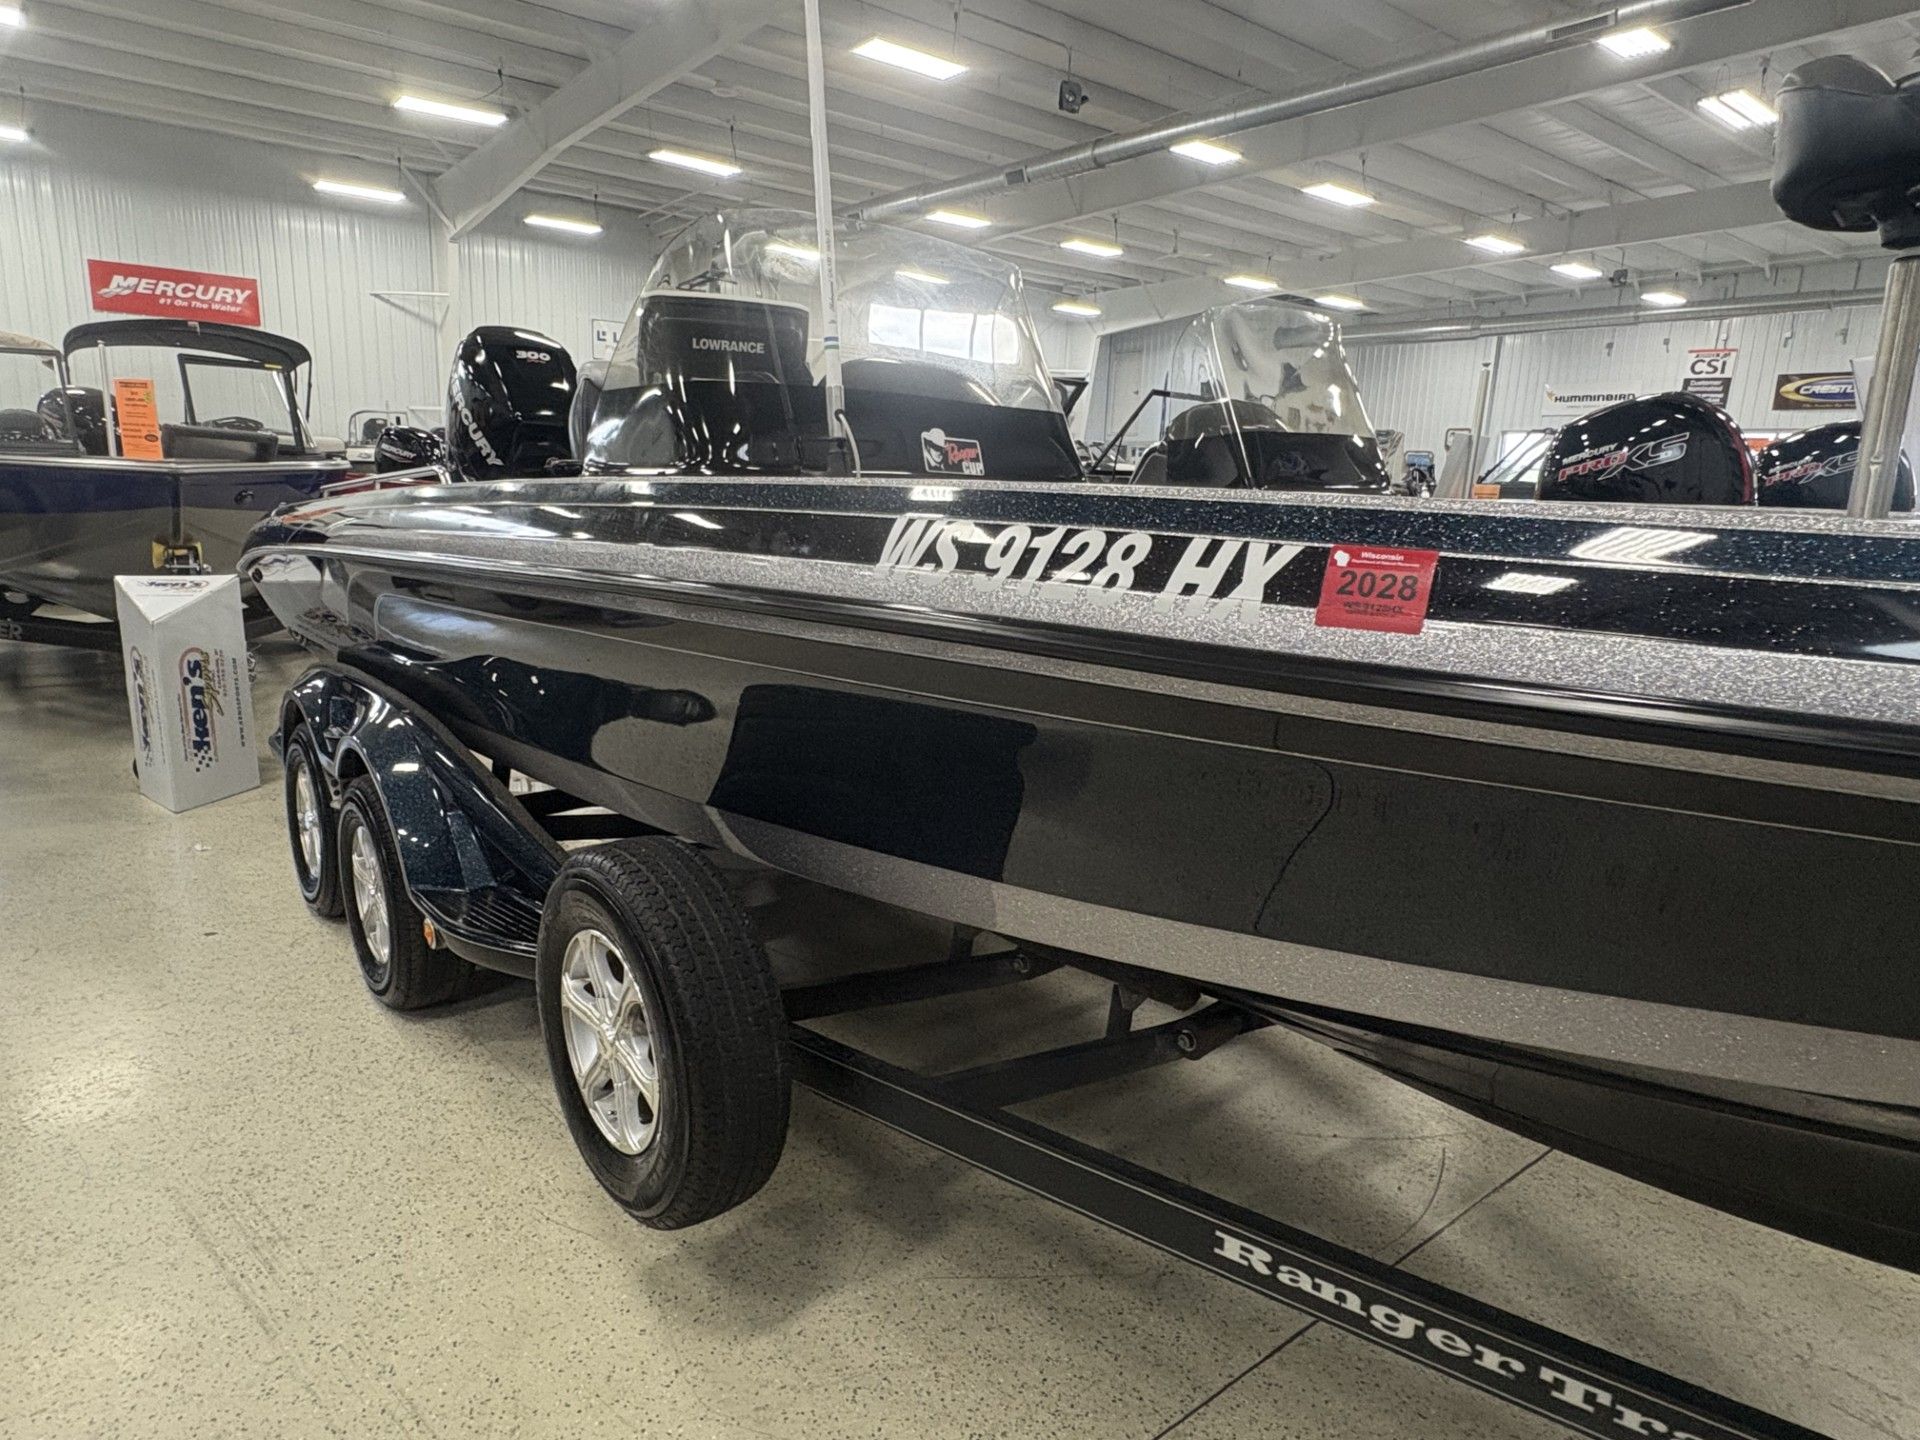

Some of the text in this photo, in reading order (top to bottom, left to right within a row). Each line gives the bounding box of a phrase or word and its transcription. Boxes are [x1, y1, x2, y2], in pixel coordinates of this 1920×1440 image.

[97, 274, 252, 304] MERCURY
[174, 299, 189, 307] On
[190, 301, 210, 309] The
[211, 303, 242, 313] Water
[692, 337, 765, 354] LOWRANCE
[515, 350, 552, 362] 300
[1690, 359, 1727, 375] CSI
[1799, 384, 1856, 395] CRESTL
[1562, 442, 1619, 465] MERCURY
[961, 462, 983, 476] CUP
[1558, 450, 1628, 482] PRO
[1361, 551, 1405, 561] Wisconsin
[873, 514, 1305, 625] WS 9128 HX
[1337, 570, 1419, 601] 2028
[182, 659, 212, 753] ken's
[1213, 1230, 1526, 1380] Ranger
